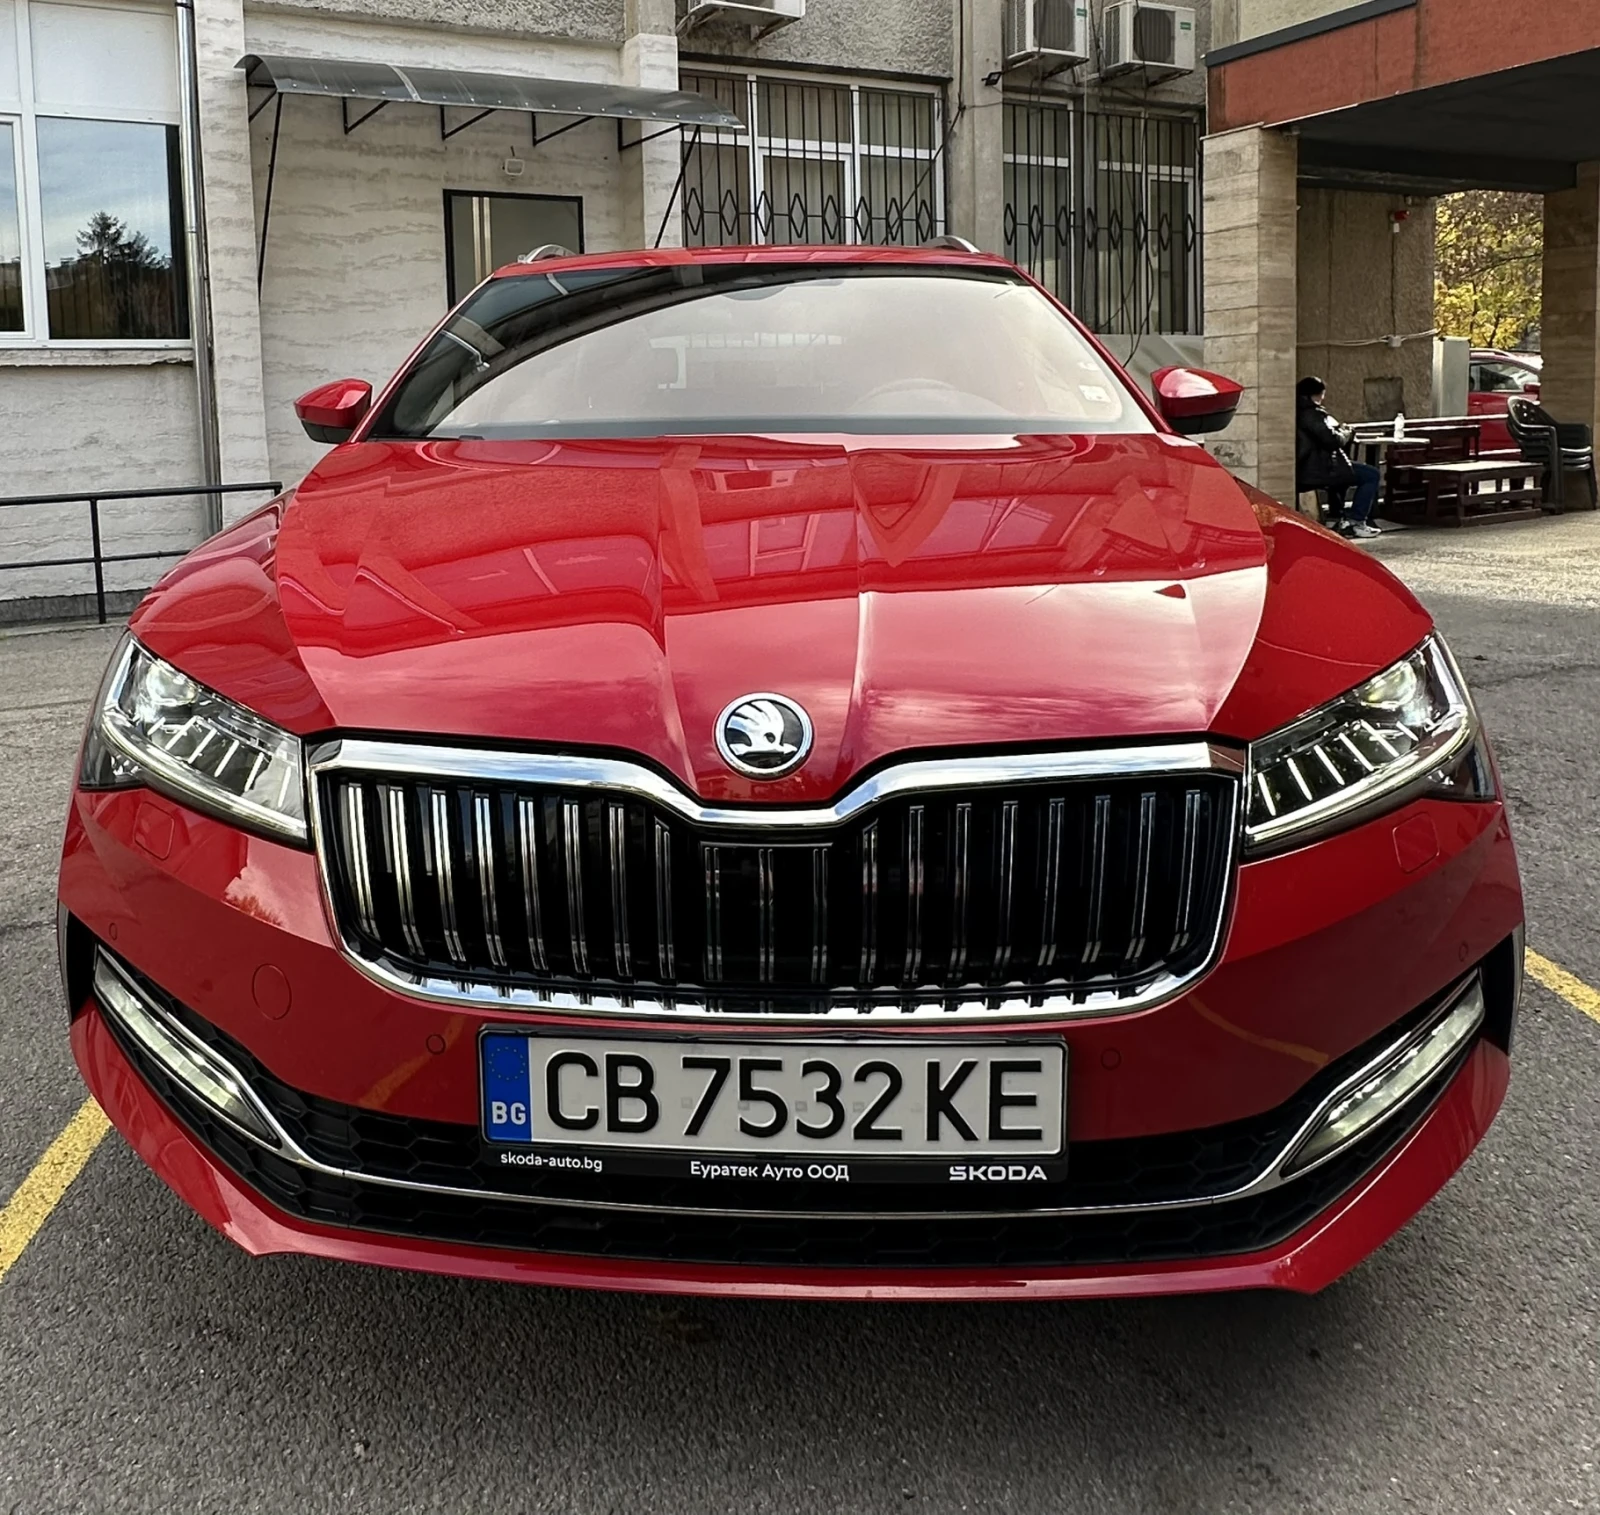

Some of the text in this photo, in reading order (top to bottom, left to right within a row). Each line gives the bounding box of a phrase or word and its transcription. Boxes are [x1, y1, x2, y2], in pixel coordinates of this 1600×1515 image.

[545, 1050, 1043, 1141] CB 7532 KE
[491, 1101, 527, 1125] BG
[500, 1151, 603, 1172] skoda-auto.bg
[690, 1160, 849, 1181] Еуратек Ауто ООД
